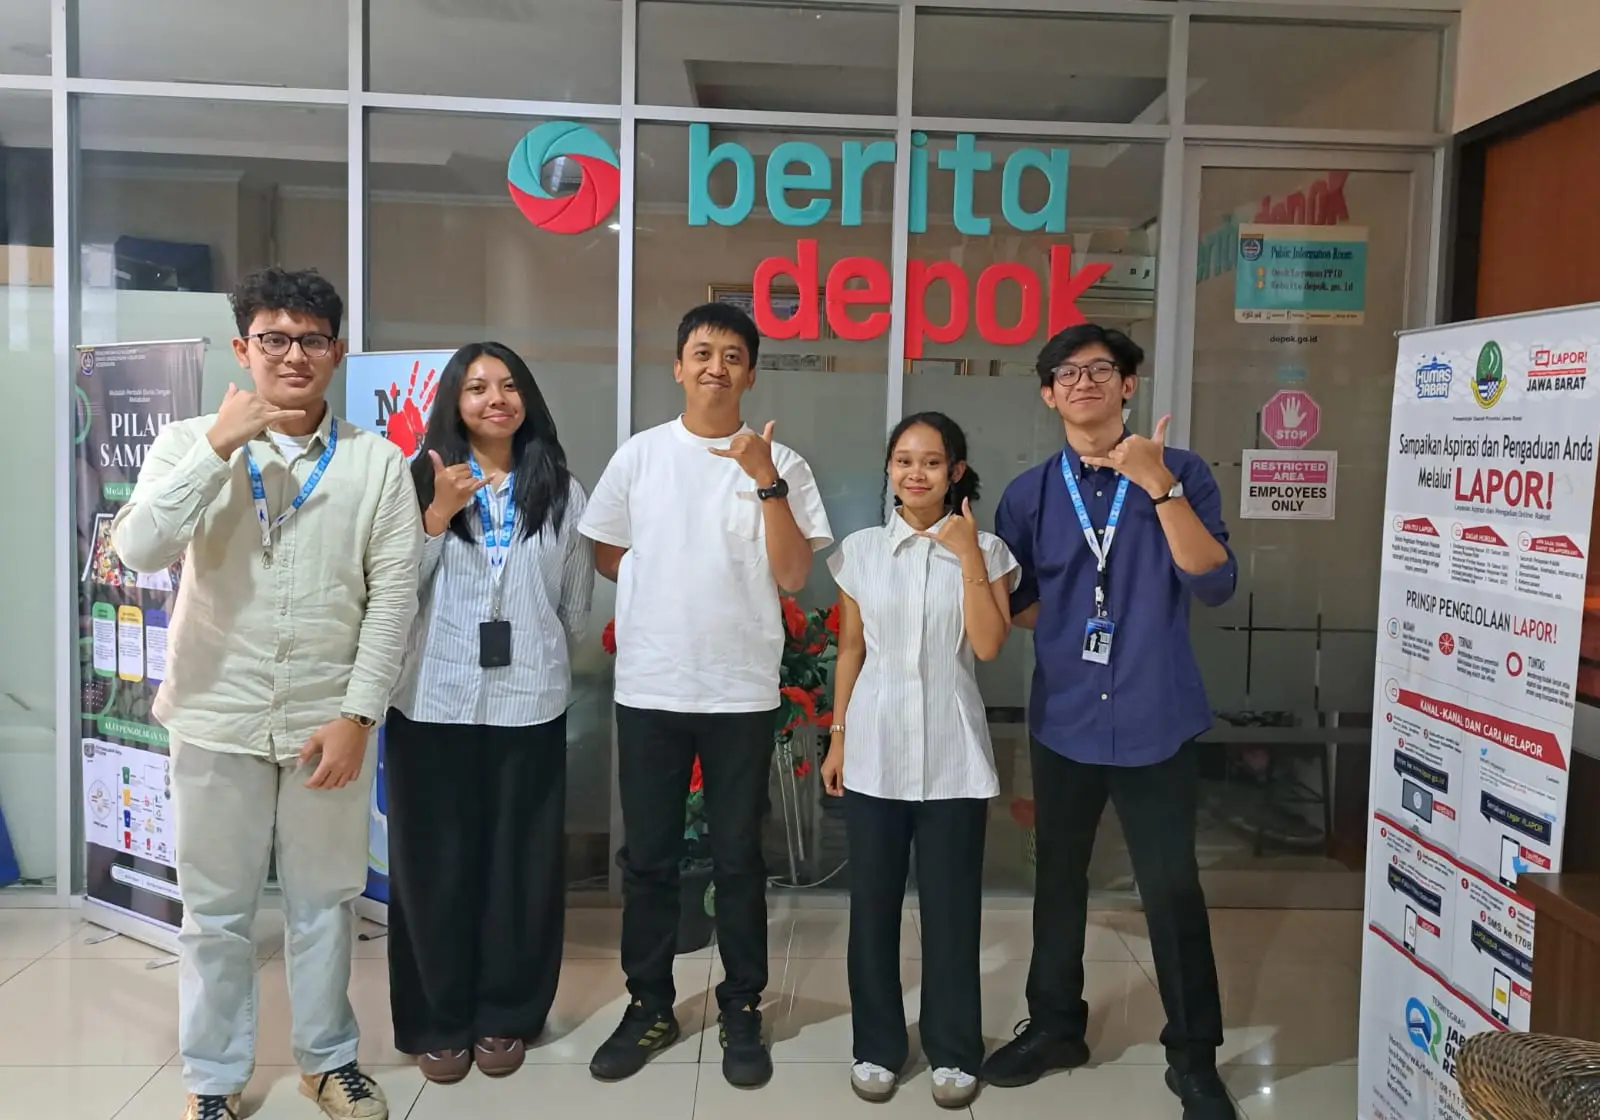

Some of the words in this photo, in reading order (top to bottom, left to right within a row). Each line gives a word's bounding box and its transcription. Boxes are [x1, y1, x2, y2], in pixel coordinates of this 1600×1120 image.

[687, 122, 1069, 235] berita
[1293, 246, 1331, 260] Information
[1333, 247, 1353, 260] Room
[752, 238, 1113, 358] depok
[1551, 351, 1588, 366] LAPOR!
[1416, 368, 1452, 383] HUMAS
[1418, 384, 1449, 398] JABAR
[1526, 377, 1552, 392] JAWA
[1555, 376, 1586, 391] BARAT
[110, 412, 171, 437] PILAH
[1275, 429, 1307, 440] STOP
[1399, 433, 1441, 460] Sampaikan
[1443, 434, 1480, 462] Aspirasi
[1482, 435, 1499, 458] dan
[1502, 434, 1560, 464] Pengaduan
[1562, 434, 1593, 462] Anda
[1252, 461, 1326, 471] RESTRICTED
[1273, 472, 1305, 481] AREA
[1249, 486, 1327, 499] EMPLOYEES
[1417, 465, 1451, 489] Melalui
[1454, 467, 1554, 510] LAPOR!
[1271, 500, 1304, 512] ONLY
[1406, 589, 1437, 614] PRINSIP
[1438, 597, 1511, 633] PENGELOLAAN
[1513, 615, 1557, 644] LAPOR!
[1465, 717, 1481, 733] DAN
[1483, 723, 1502, 741] CARA
[1503, 733, 1543, 758] MELAPOR
[1487, 915, 1502, 933] SMS
[1504, 927, 1513, 939] ke
[1514, 933, 1532, 951] 1708
[1446, 1025, 1466, 1046] JAB
